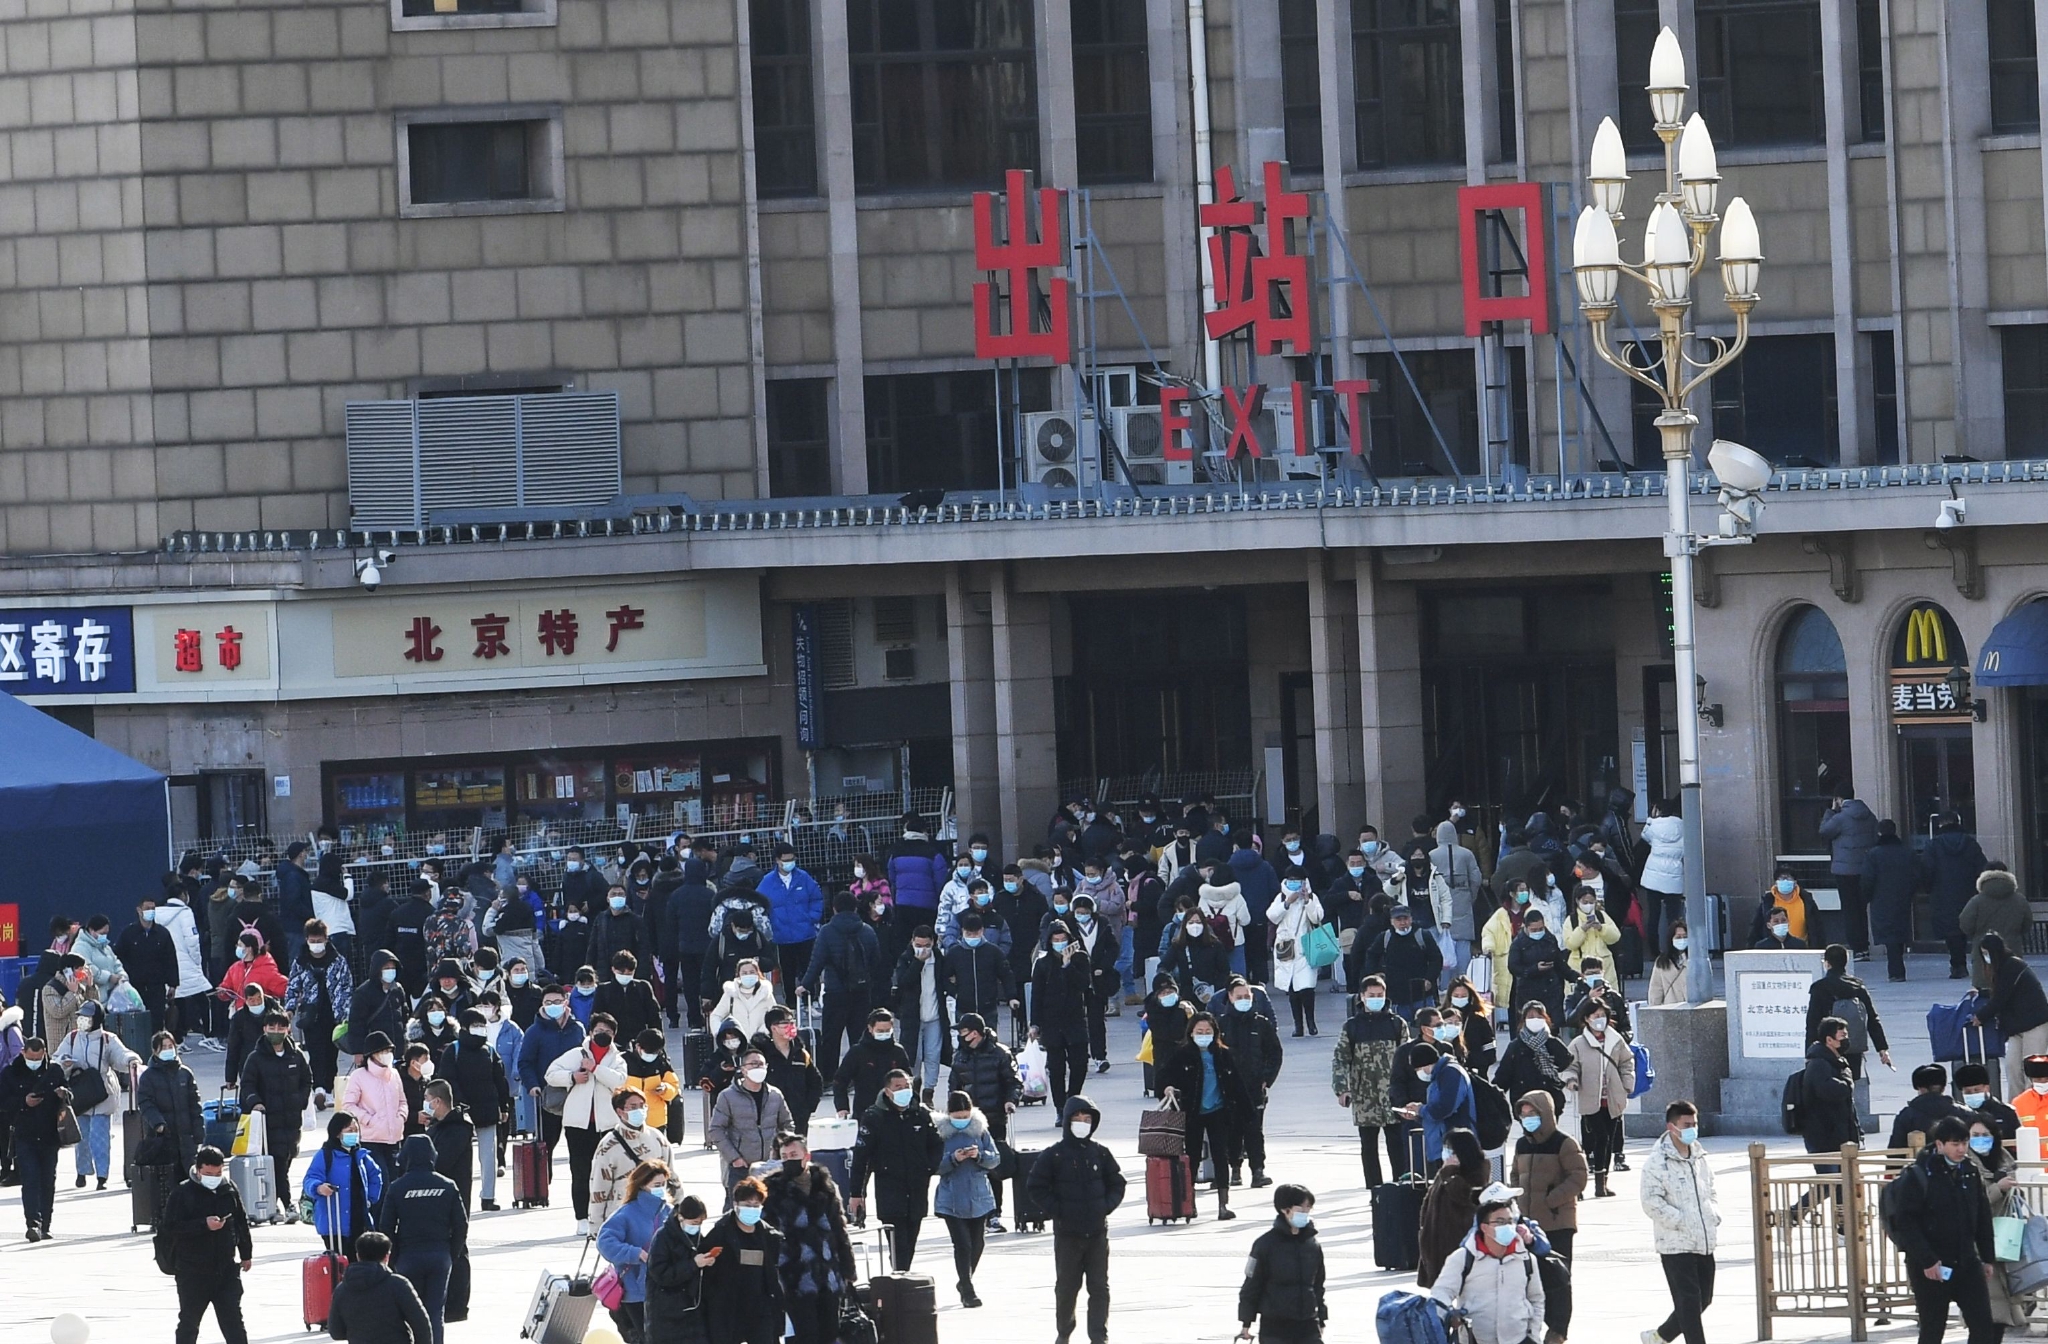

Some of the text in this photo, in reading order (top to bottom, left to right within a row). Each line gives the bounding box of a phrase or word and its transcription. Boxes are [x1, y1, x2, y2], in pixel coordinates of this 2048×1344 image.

[973, 160, 1556, 364] 出站口
[1160, 379, 1371, 461] EXIT
[174, 625, 243, 672] 超市
[404, 604, 645, 662] 北京特产
[1892, 682, 1956, 712] 麦当劳
[0, 922, 14, 943] 岗
